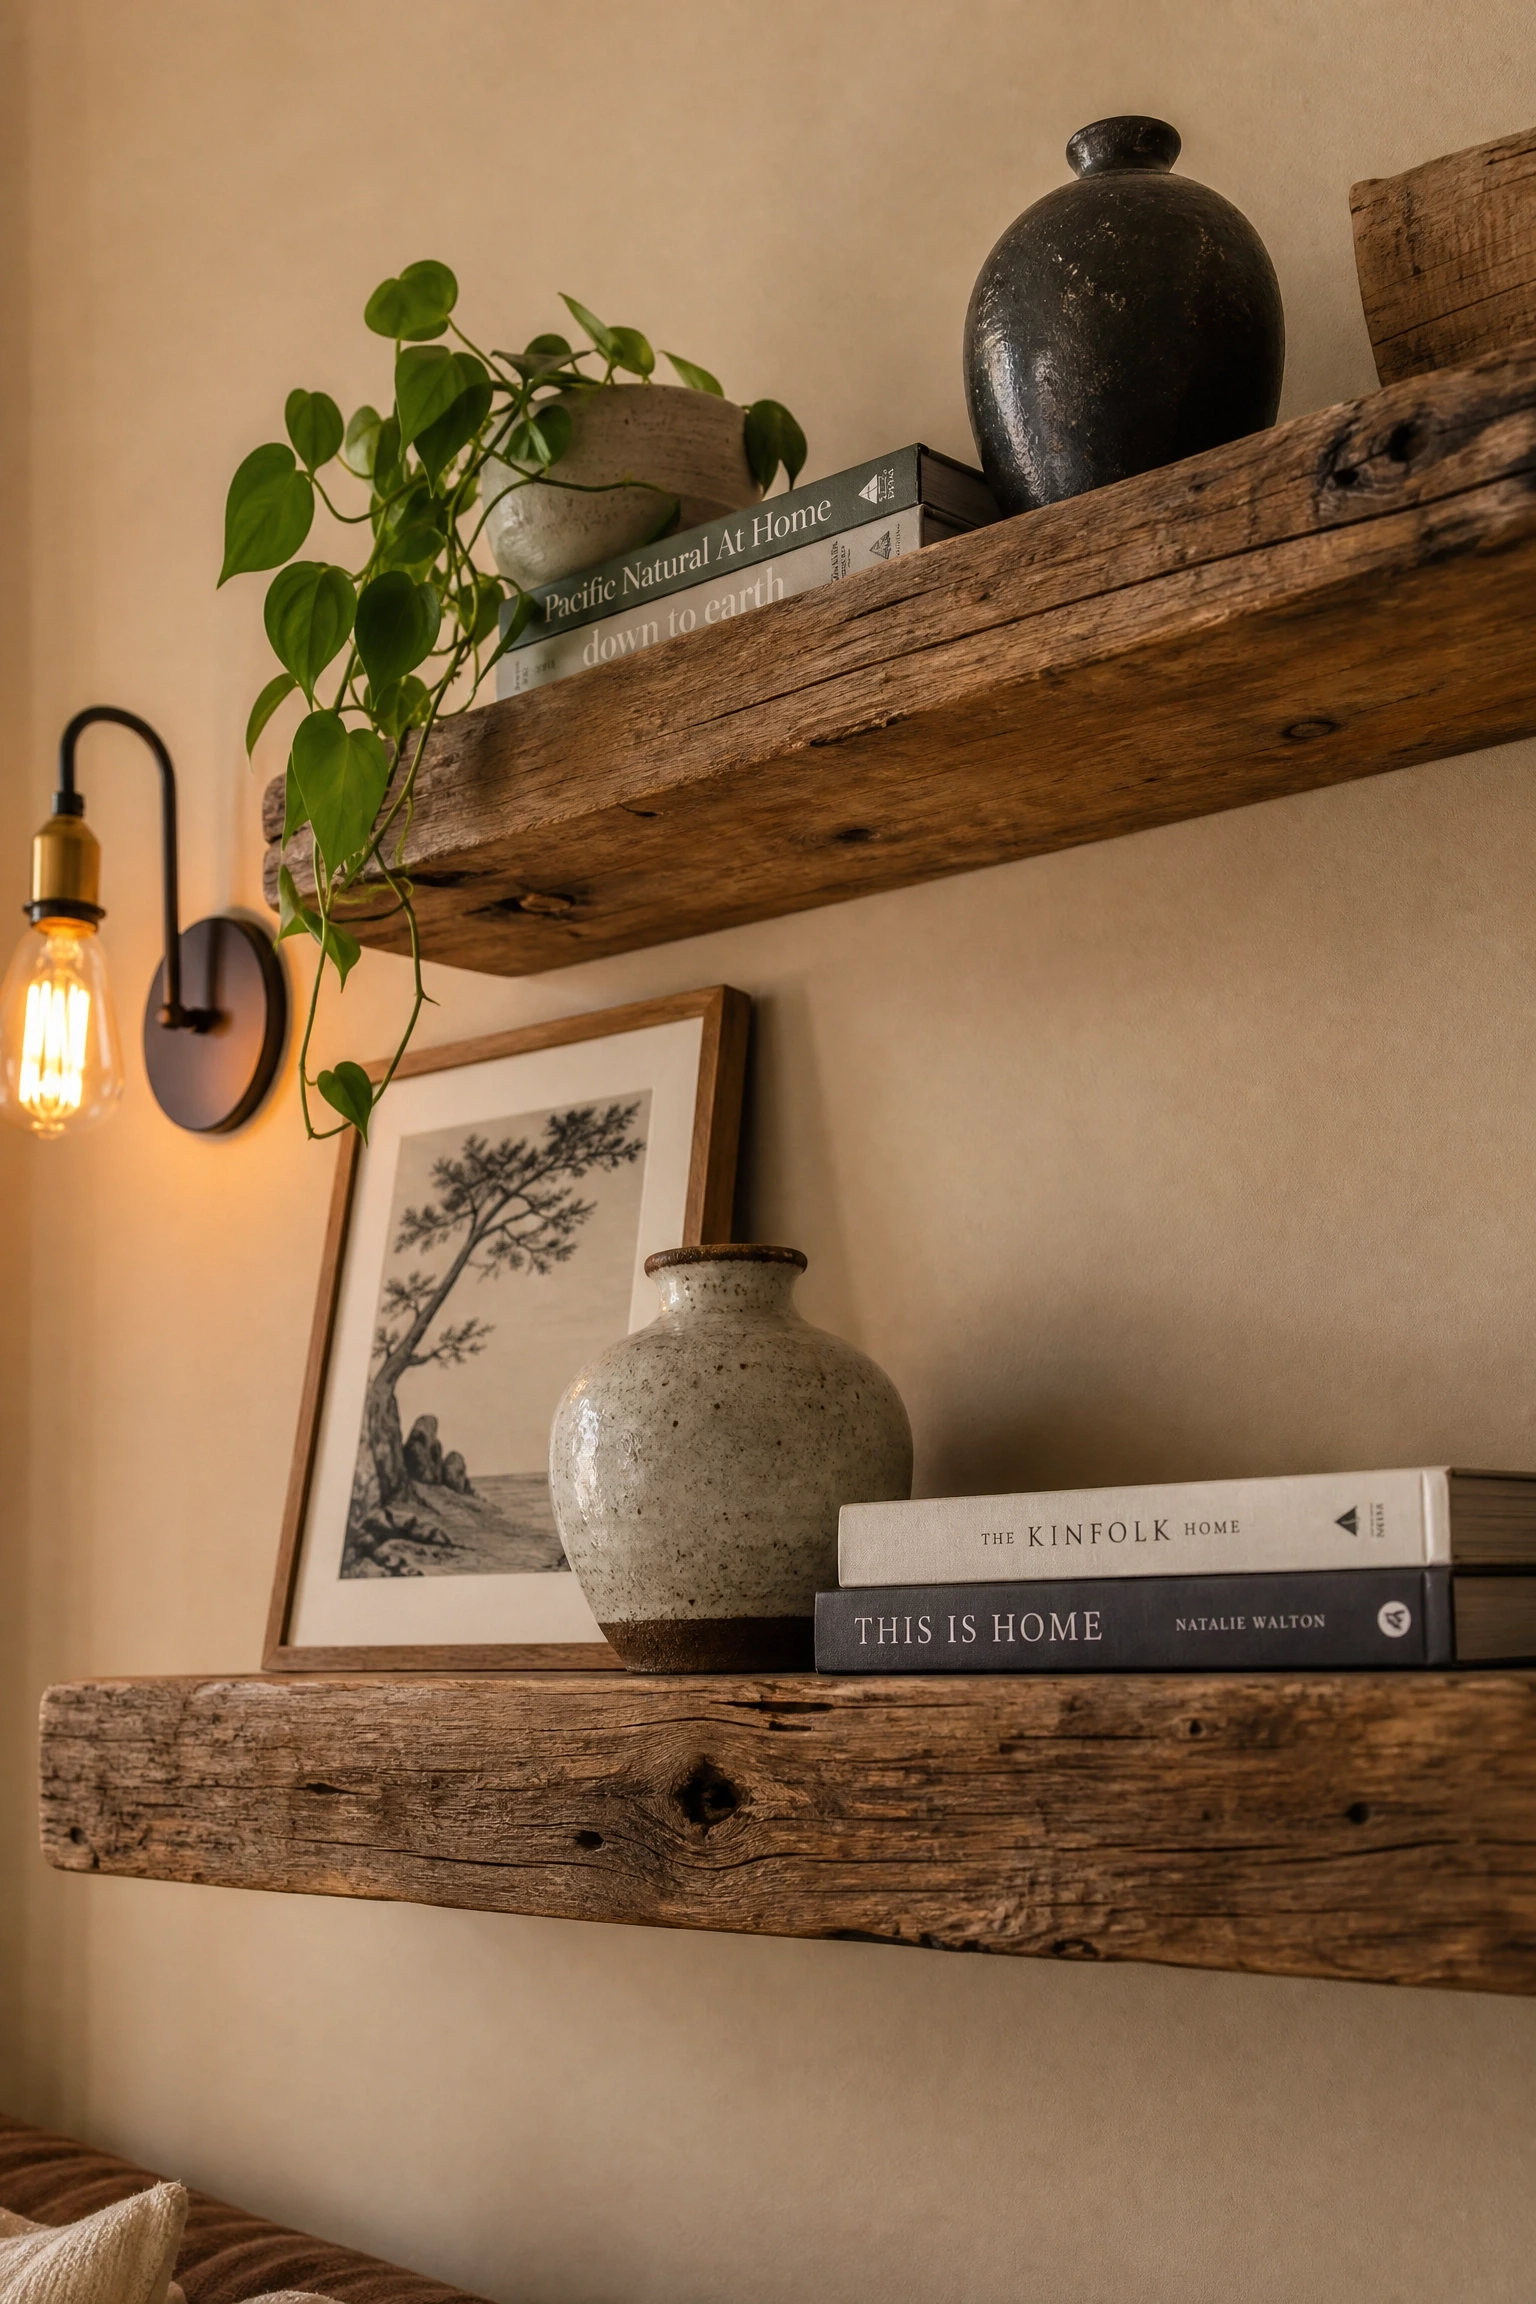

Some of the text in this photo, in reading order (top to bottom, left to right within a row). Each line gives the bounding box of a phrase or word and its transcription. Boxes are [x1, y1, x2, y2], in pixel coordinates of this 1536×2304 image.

[545, 500, 832, 623] Pacific Natural At Home
[583, 628, 659, 667] down
[668, 608, 696, 638] to
[704, 566, 784, 624] earth
[981, 1519, 1240, 1547] THE KINFOLK HOME
[854, 1611, 1102, 1645] THIS IS HOME
[1176, 1613, 1325, 1631] NATALIE WALTON
